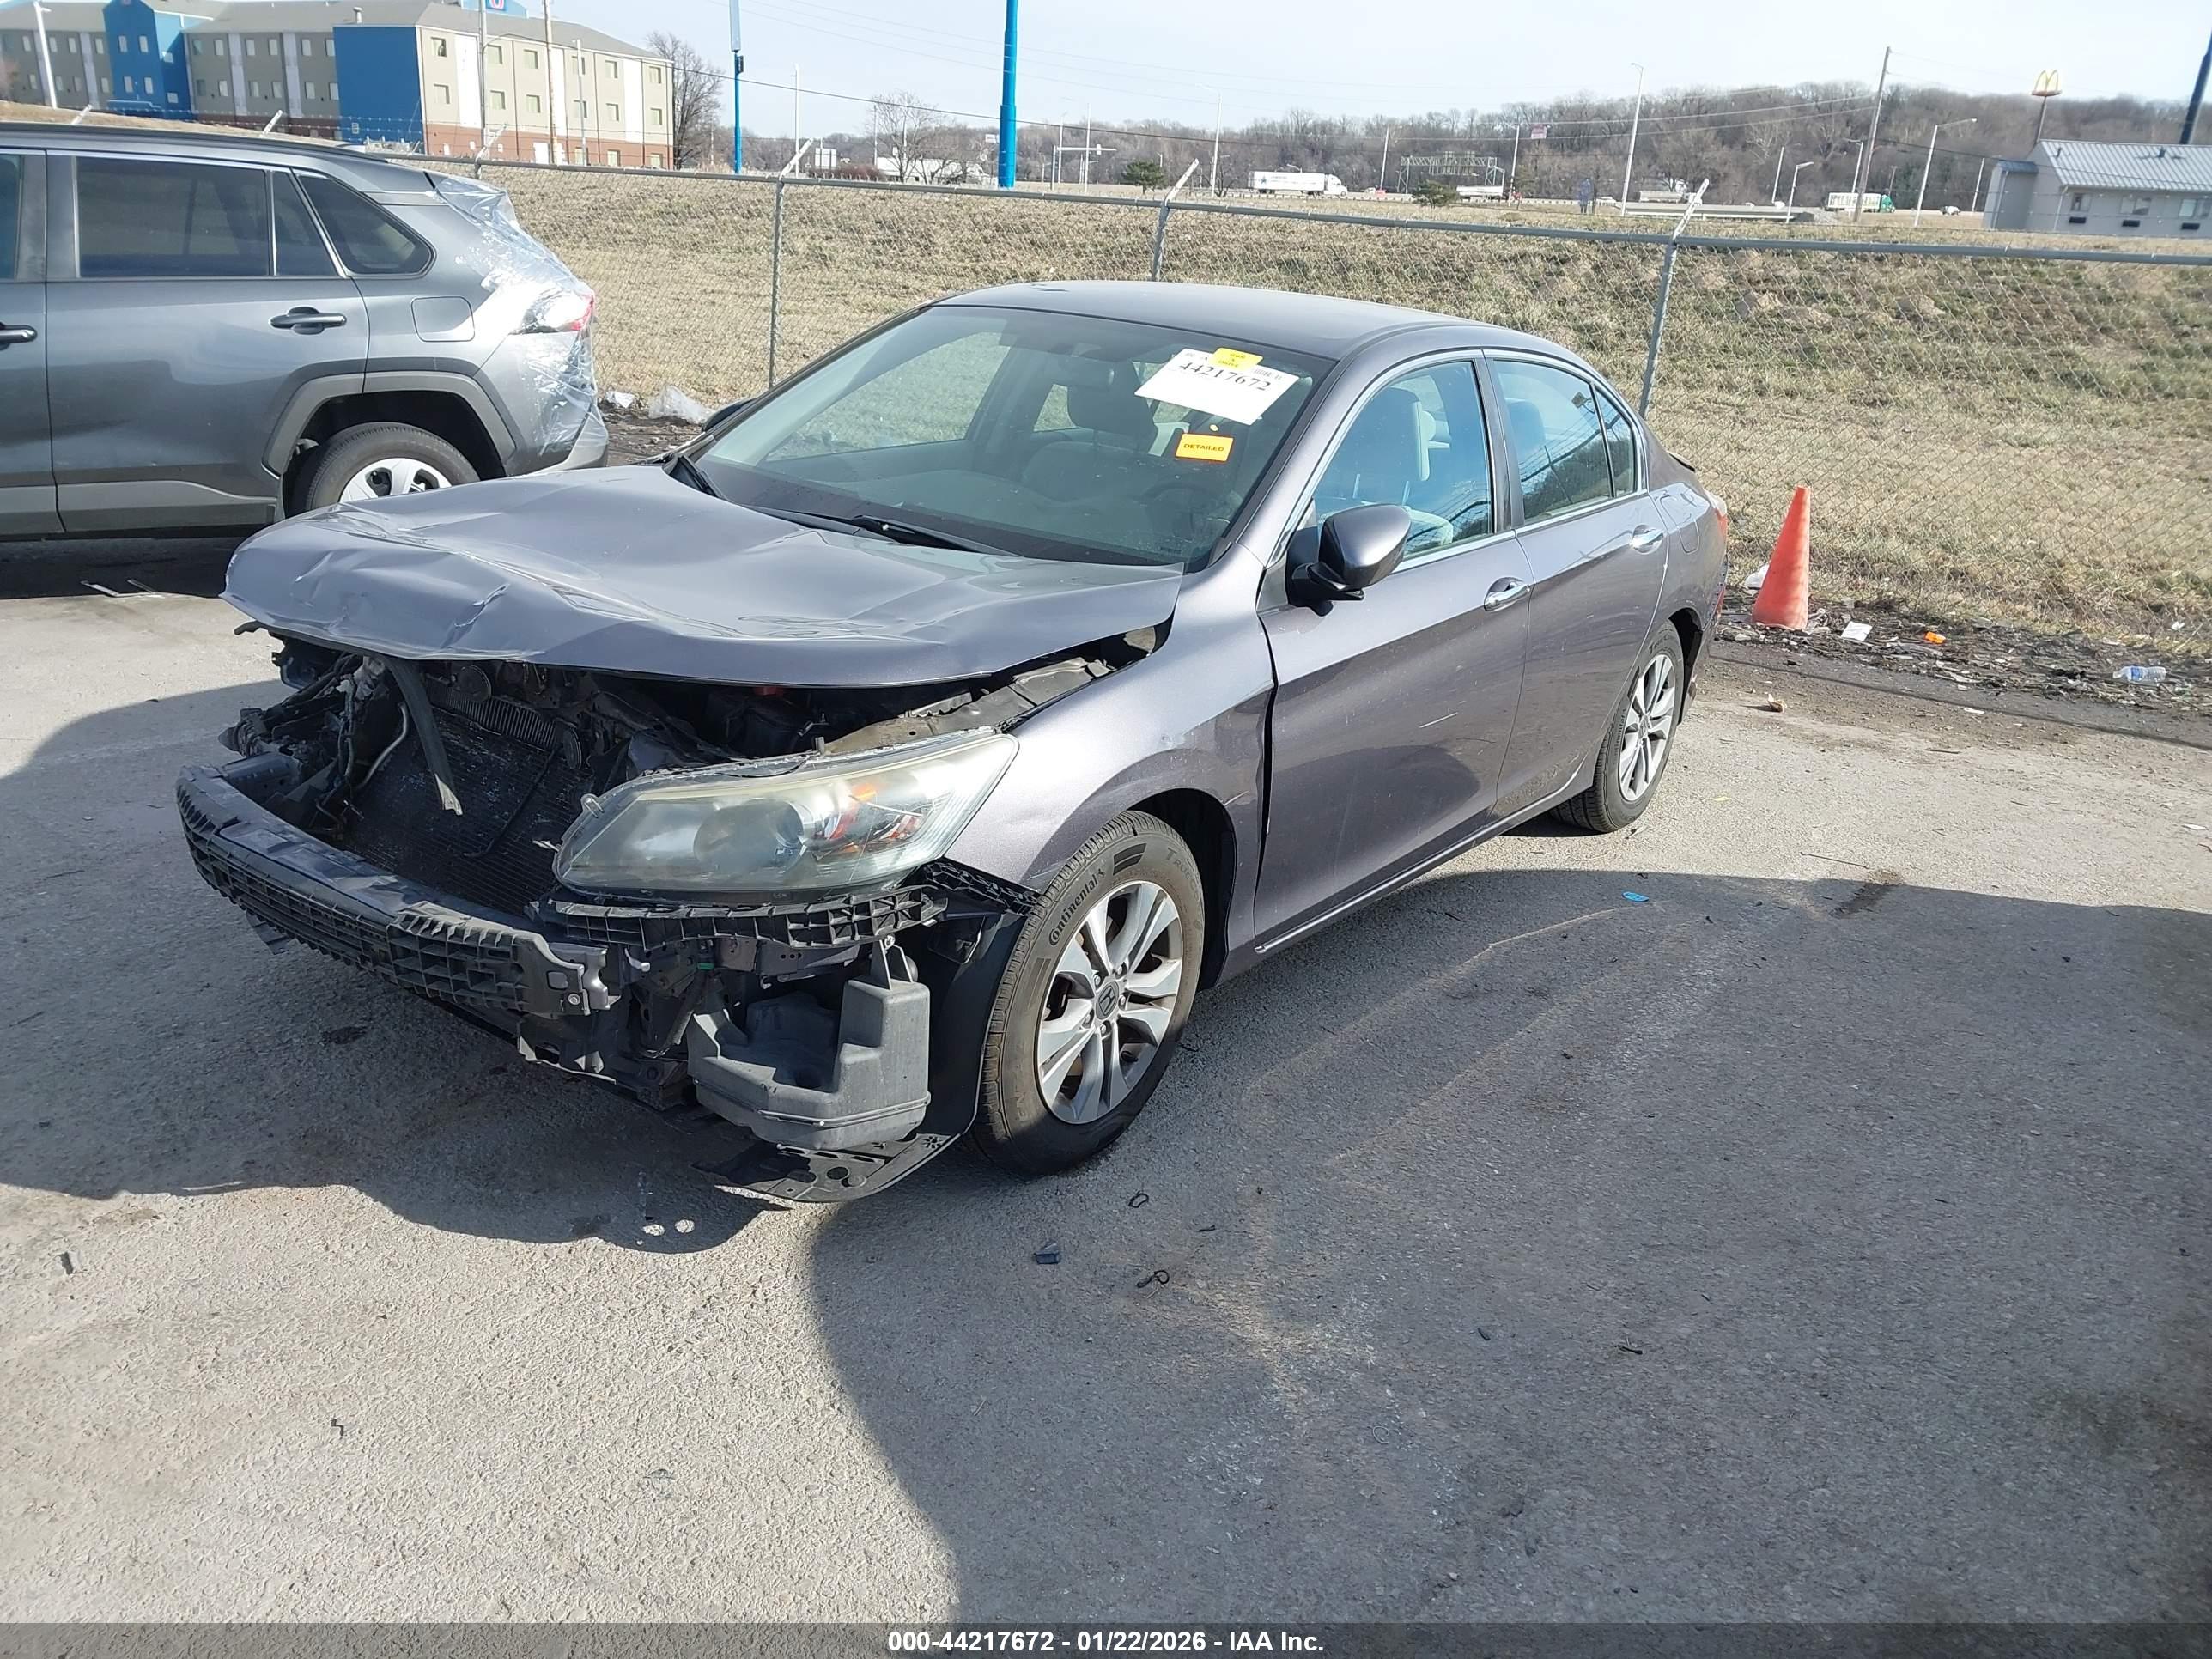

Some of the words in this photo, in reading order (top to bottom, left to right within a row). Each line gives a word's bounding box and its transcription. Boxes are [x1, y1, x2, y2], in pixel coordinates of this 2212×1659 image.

[1179, 362, 1271, 391] 44217672
[1183, 443, 1224, 452] DETAILED
[1048, 874, 1099, 946] Continental
